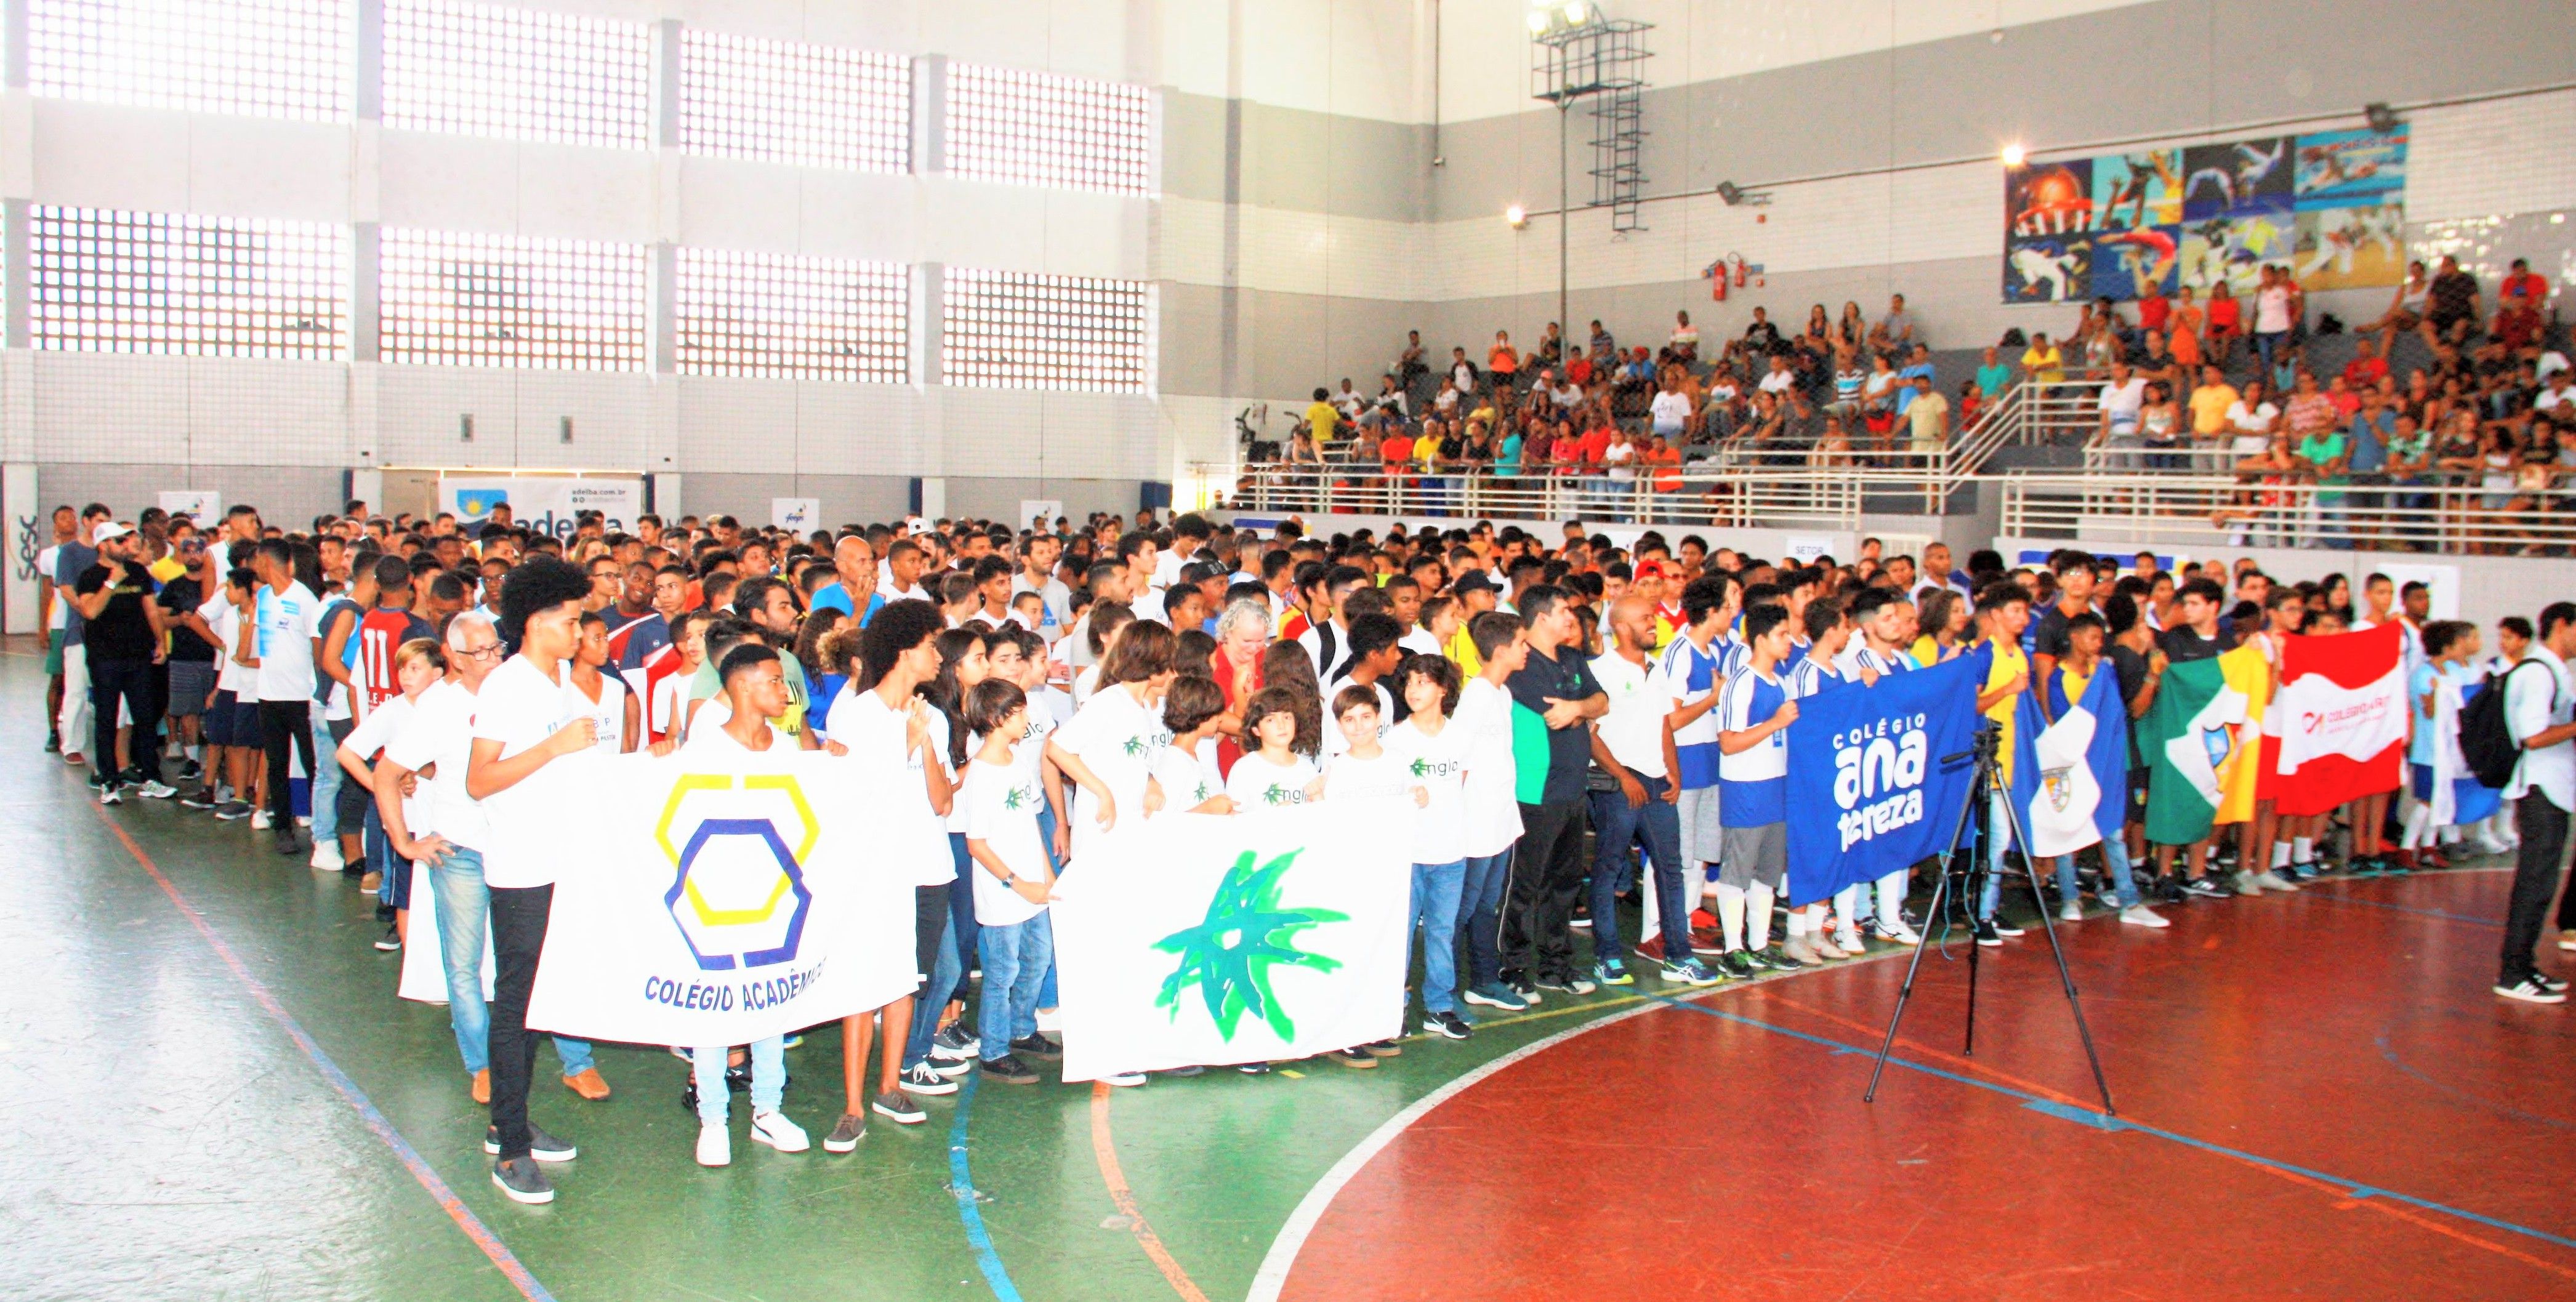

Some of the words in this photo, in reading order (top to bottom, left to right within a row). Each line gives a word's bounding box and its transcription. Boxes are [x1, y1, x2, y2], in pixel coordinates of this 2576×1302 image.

[515, 510, 623, 540] adea
[1796, 546, 1824, 555] SETOR
[364, 627, 390, 689] 11
[1833, 712, 1926, 750] COLÉGIO
[1833, 729, 1927, 810] ana
[1837, 789, 1923, 853] tereza
[645, 976, 733, 1011] COLÉGIO
